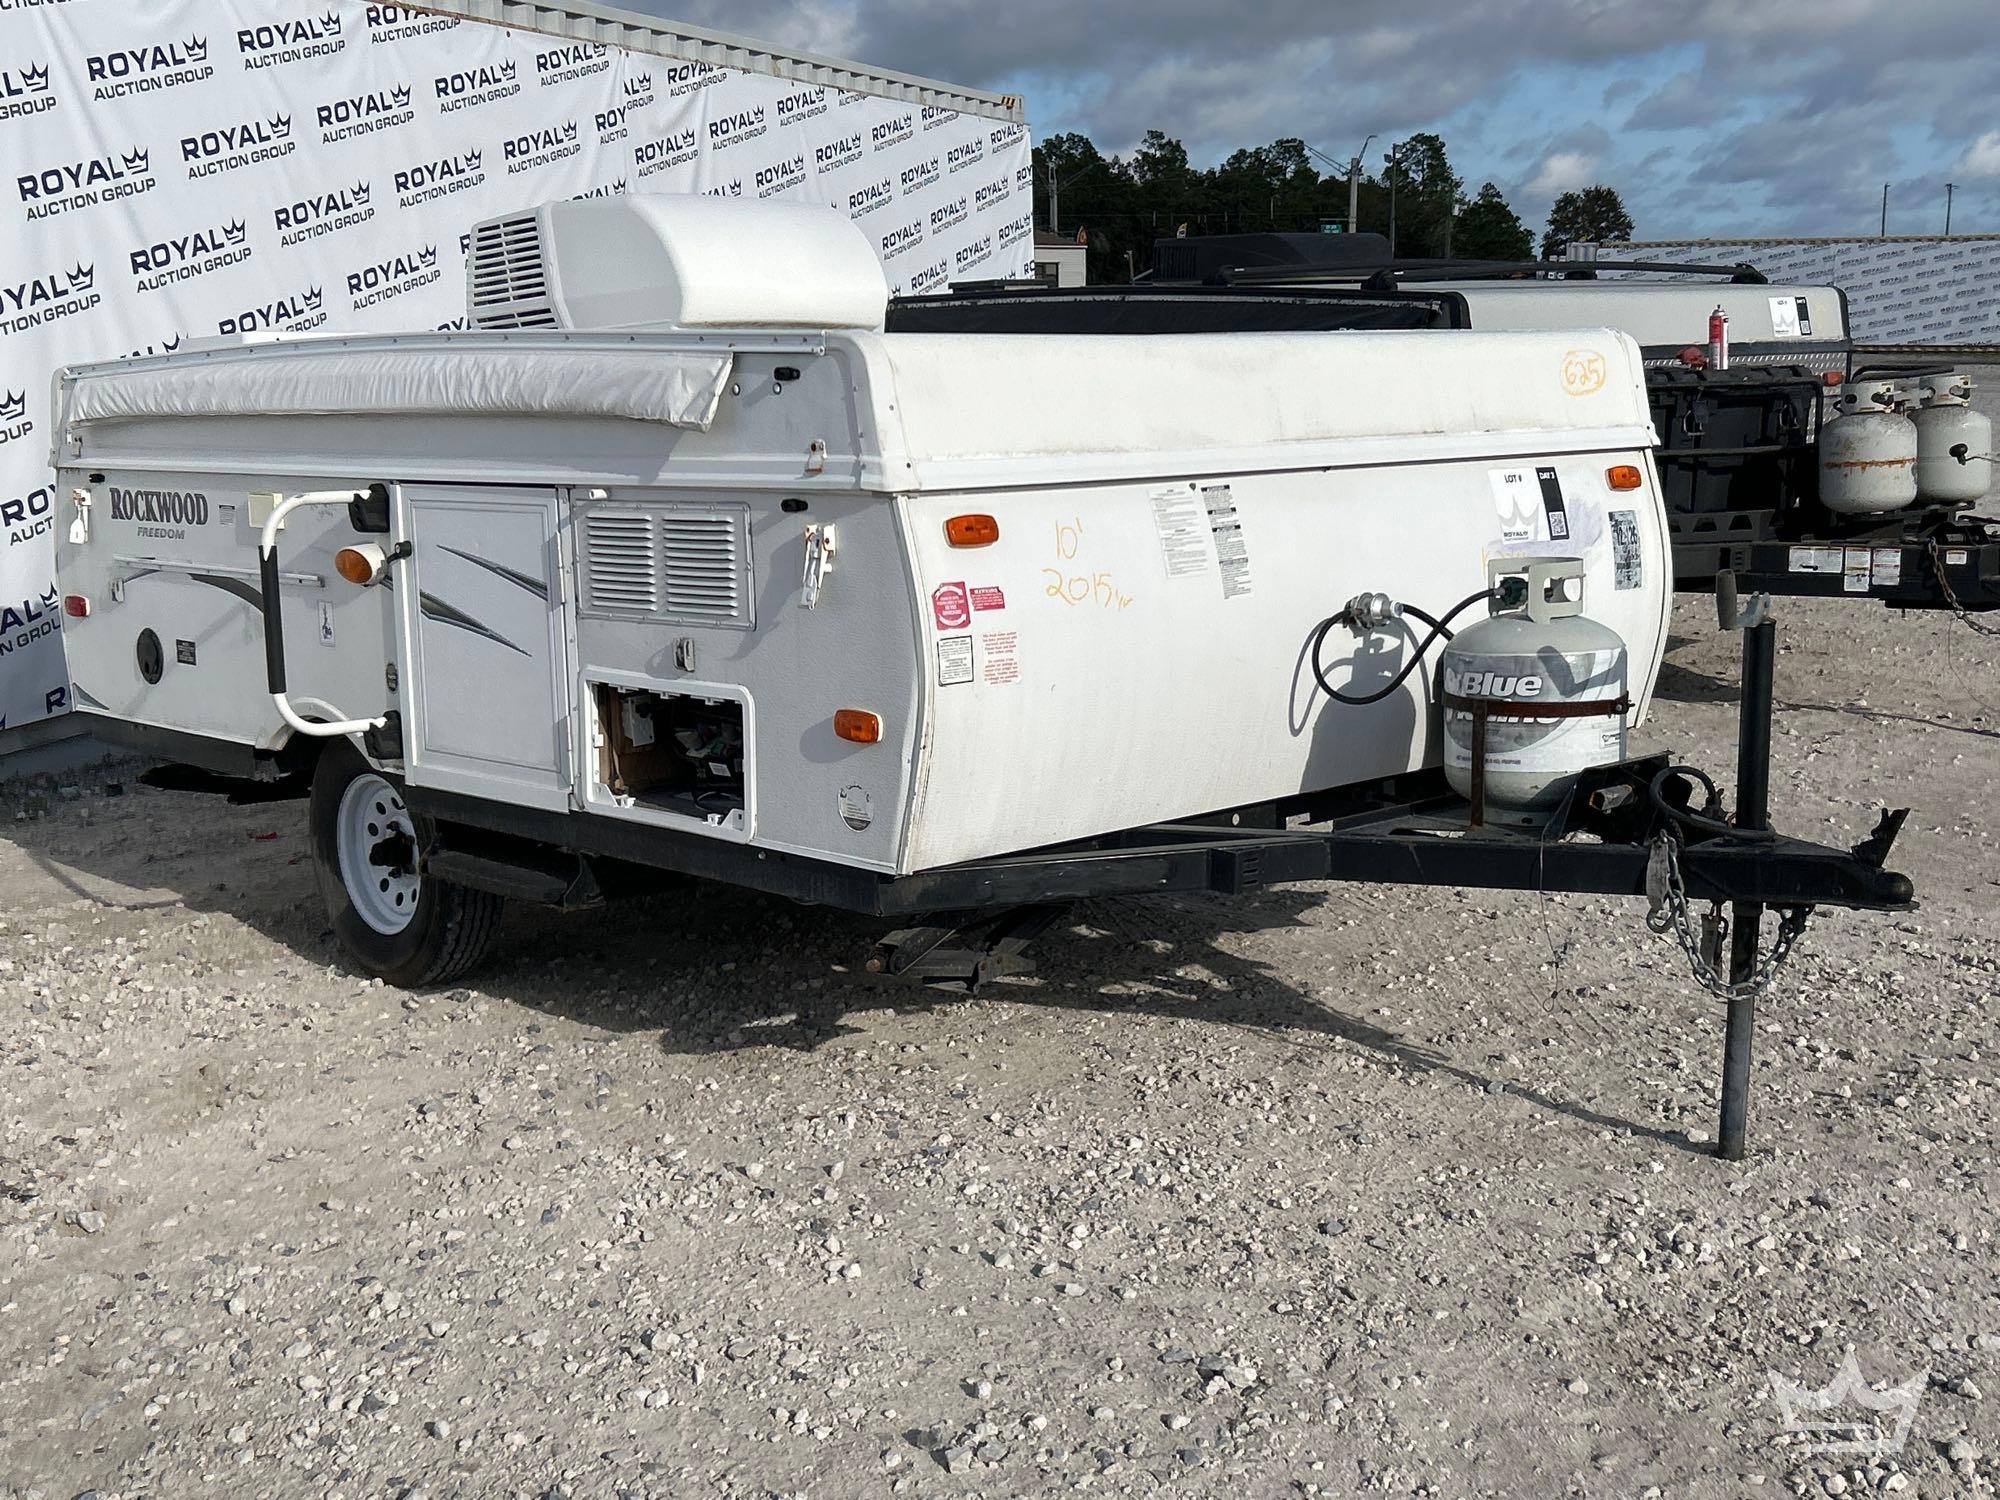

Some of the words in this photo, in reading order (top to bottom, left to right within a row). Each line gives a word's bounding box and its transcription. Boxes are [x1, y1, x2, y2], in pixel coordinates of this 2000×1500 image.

[238, 19, 323, 52] ROYAL
[371, 26, 421, 44] AUCTION
[423, 18, 460, 34] GROUP
[86, 43, 185, 81] ROYAL
[244, 49, 300, 70] AUCTION
[303, 40, 345, 59] GROUP
[536, 43, 593, 72] ROYAL
[94, 77, 162, 101] AUCTION
[165, 66, 213, 87] GROUP
[435, 66, 502, 98] ROYAL
[541, 67, 579, 87] AUCTION
[580, 61, 609, 76] GROUP
[441, 92, 486, 114] AUCTION
[487, 84, 520, 101] GROUP
[627, 95, 654, 110] GROUP
[670, 80, 702, 98] AUCTION
[777, 91, 816, 115] ROYAL
[317, 92, 392, 127] ROYAL
[780, 112, 806, 127] AUCTION
[807, 105, 827, 117] GROUP
[322, 122, 374, 144] AUCTION
[376, 111, 414, 130] GROUP
[709, 111, 754, 138] ROYAL
[712, 132, 743, 151] AUCTION
[744, 126, 766, 140] GROUP
[872, 118, 904, 141] ROYAL
[990, 124, 1016, 144] ROYAL
[180, 122, 271, 161] ROYAL
[504, 128, 563, 160] ROYAL
[635, 135, 683, 165] ROYAL
[816, 139, 852, 163] ROYAL
[948, 142, 975, 164] ROYAL
[188, 154, 249, 180] AUCTION
[251, 142, 295, 163] GROUP
[508, 154, 550, 174] AUCTION
[550, 144, 580, 161] GROUP
[638, 158, 671, 178] AUCTION
[672, 150, 699, 166] GROUP
[901, 161, 931, 185] ROYAL
[18, 156, 124, 201] ROYAL
[394, 157, 465, 193] ROYAL
[756, 160, 795, 188] ROYAL
[758, 182, 785, 199] AUCTION
[786, 174, 806, 188] GROUP
[26, 191, 98, 221] AUCTION
[102, 178, 156, 202] GROUP
[399, 184, 447, 209] AUCTION
[449, 174, 485, 193] GROUP
[849, 184, 882, 209] ROYAL
[976, 180, 1002, 203] ROYAL
[275, 190, 352, 230] ROYAL
[931, 201, 959, 225] ROYAL
[281, 221, 333, 248] AUCTION
[335, 208, 375, 230] GROUP
[882, 224, 914, 250] ROYAL
[999, 218, 1024, 241] ROYAL
[130, 230, 225, 275] ROYAL
[956, 240, 984, 264] ROYAL
[137, 262, 201, 293] AUCTION
[205, 248, 251, 272] GROUP
[347, 254, 419, 295] ROYAL
[911, 264, 940, 290] ROYAL
[353, 284, 401, 311] AUCTION
[403, 270, 440, 292] GROUP
[44, 294, 101, 322] GROUP
[1565, 360, 1600, 385] 625
[1504, 474, 1516, 483] LOT
[110, 488, 208, 525] ROCKWOOD
[137, 526, 185, 539] FREEDOM
[1041, 568, 1112, 607] 2015
[1462, 672, 1542, 697] Blue
